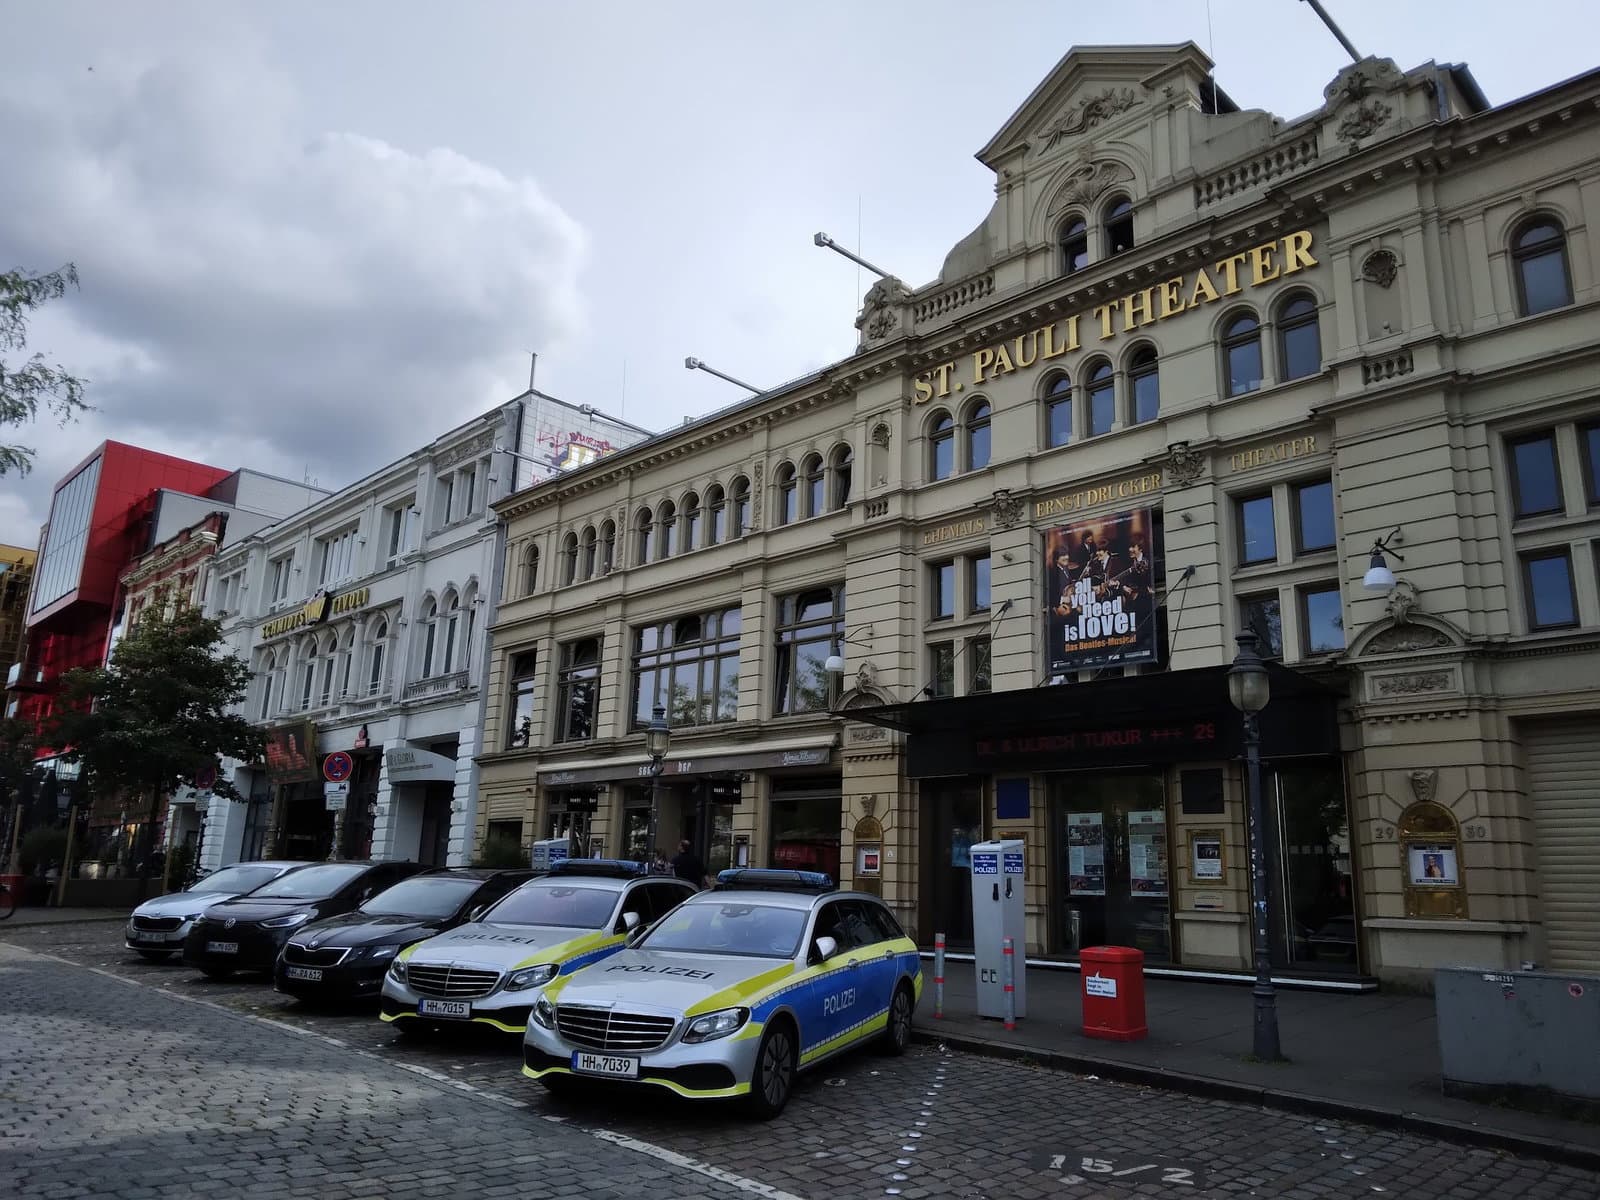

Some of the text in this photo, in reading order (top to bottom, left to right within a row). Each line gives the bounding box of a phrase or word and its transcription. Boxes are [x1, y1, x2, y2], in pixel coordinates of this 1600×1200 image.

[913, 230, 1318, 406] ST. PAULI THEATER
[1229, 436, 1318, 473] THEATER
[1035, 473, 1163, 519] ERNST DRUCKER
[923, 517, 984, 547] EHEMALS
[1074, 577, 1092, 595] all
[333, 587, 369, 615] TIVOLI
[1070, 591, 1096, 609] you
[1082, 596, 1122, 618] need
[1064, 611, 1137, 642] is love!
[1083, 729, 1143, 748] TUKUR
[1375, 826, 1394, 839] 29
[1465, 825, 1487, 839] 30
[448, 934, 536, 945] POLIZEI
[605, 963, 716, 981] POLIZEI
[442, 1002, 465, 1014] 7015
[823, 987, 857, 1018] POLIZEI
[582, 1055, 631, 1073] HH 7039
